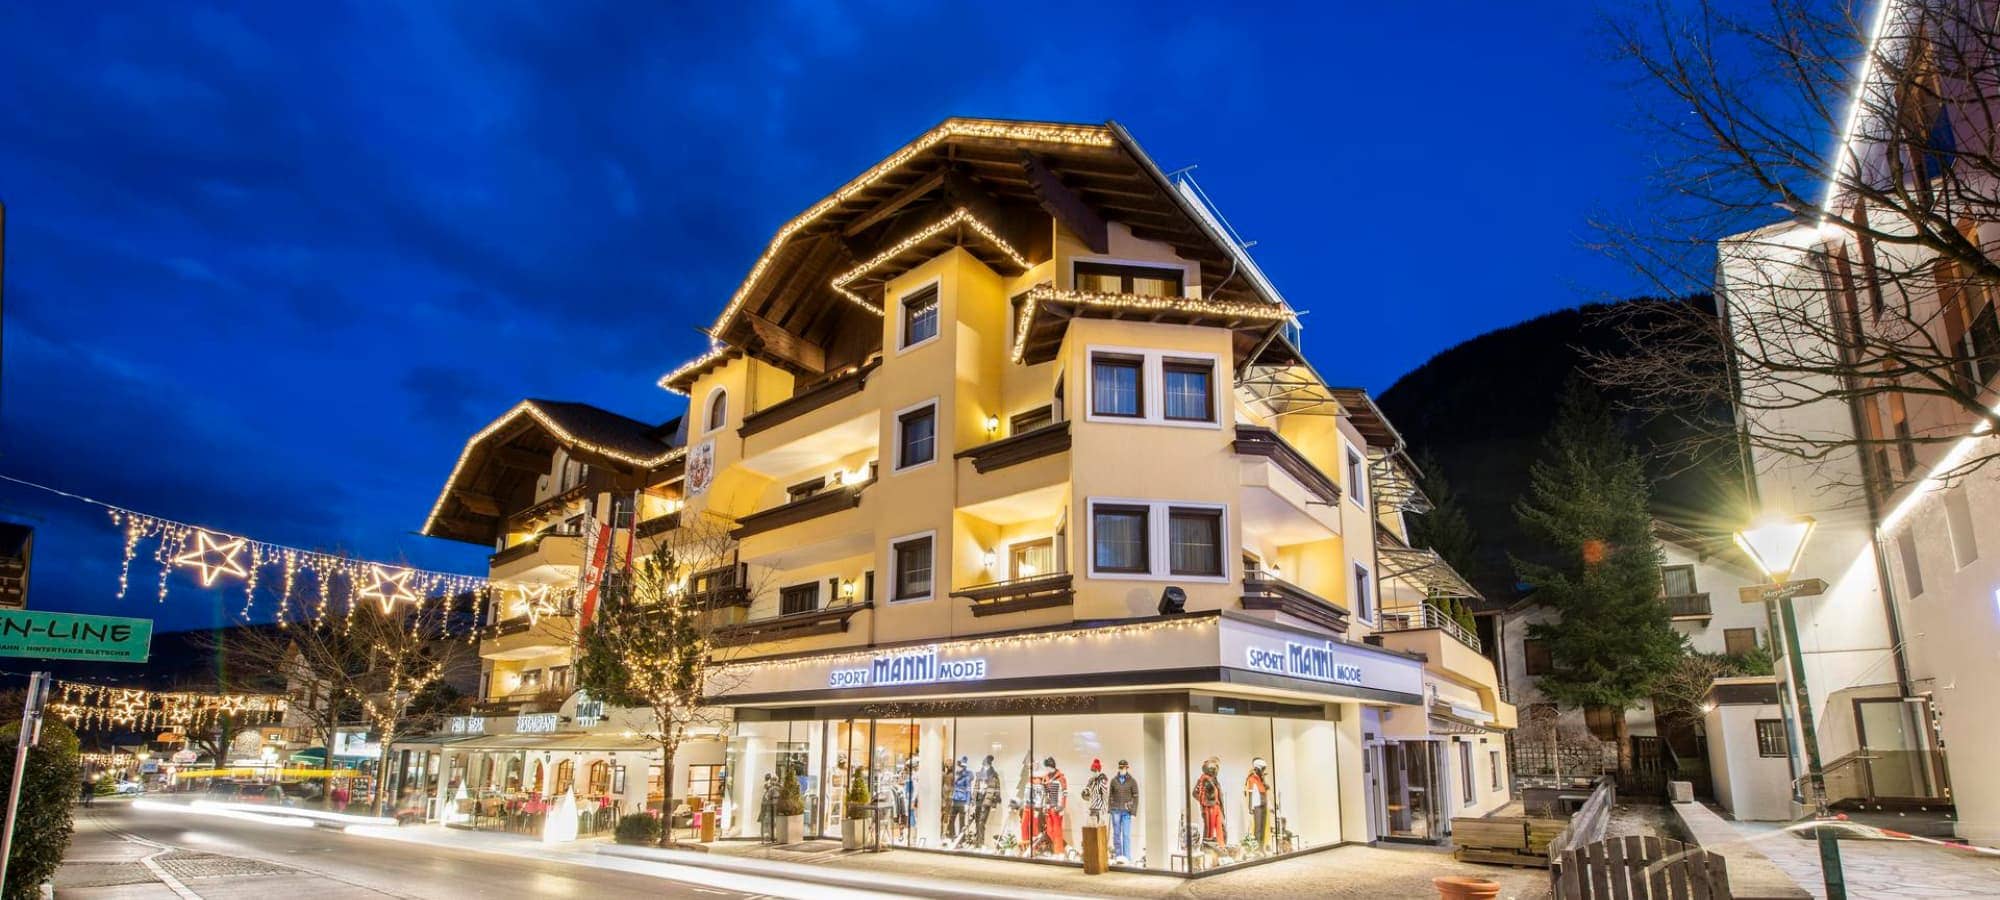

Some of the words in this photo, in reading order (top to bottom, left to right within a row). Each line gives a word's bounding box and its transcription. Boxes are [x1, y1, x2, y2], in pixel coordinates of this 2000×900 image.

[0, 617, 131, 642] N-LINE
[85, 648, 130, 657] GLETSCHER
[830, 670, 867, 686] SPORT
[939, 661, 984, 678] MODE
[1249, 649, 1284, 670] SPORT
[1337, 665, 1361, 682] MODE
